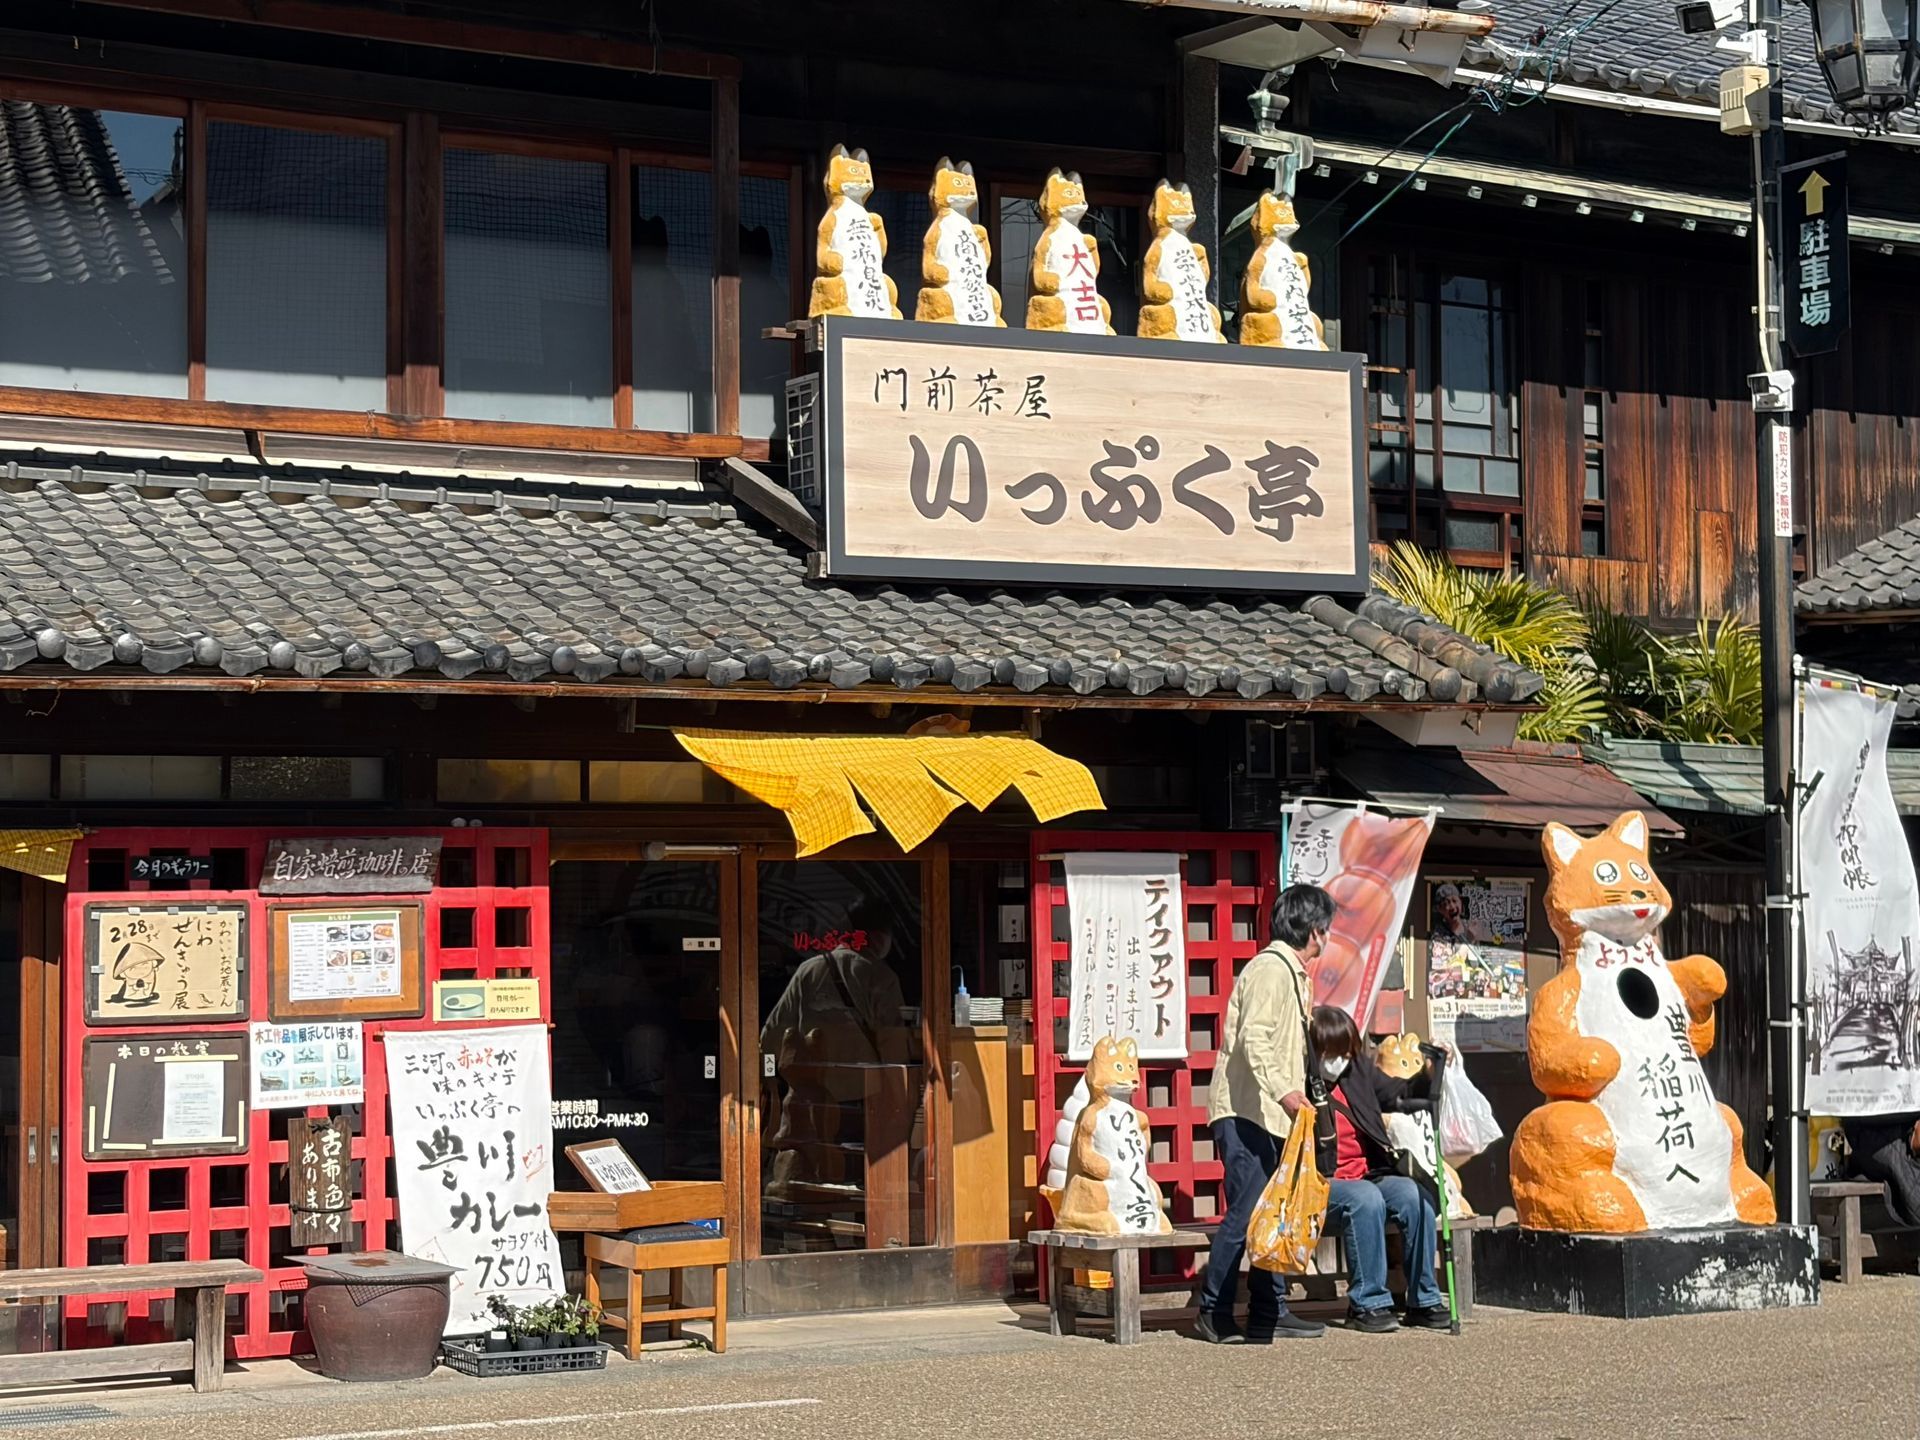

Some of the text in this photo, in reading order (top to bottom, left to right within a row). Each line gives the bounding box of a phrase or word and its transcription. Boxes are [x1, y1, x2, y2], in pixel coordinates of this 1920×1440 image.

[1062, 243, 1100, 322] 大吉
[1798, 218, 1831, 328] 駐車場
[873, 367, 1053, 419] 門前茶屋
[908, 434, 1326, 543] いっぷく亭
[1778, 431, 1790, 533] 防犯カメラ監視中
[134, 858, 209, 877] 今月のギャラリー
[273, 848, 433, 881] 自家焙煎珈琲の店
[1145, 879, 1175, 1039] テイクアウト
[1595, 940, 1661, 969] ようこそ
[1122, 936, 1142, 1034] 出来ます。
[117, 1040, 210, 1059] 本日の教室
[254, 1026, 359, 1044] 木工作品を展示しています。
[405, 1045, 517, 1075] 三河の赤みそが
[1669, 1005, 1712, 1107] 豊川
[303, 1089, 362, 1098] 中に入って見てね。
[416, 1092, 521, 1122] いっぷく亭の
[433, 1069, 517, 1095] 味のキメテ
[1637, 1055, 1701, 1184] 稲荷へ
[321, 1128, 345, 1234] 古布色々
[416, 1124, 516, 1191] 豊川
[1110, 1110, 1155, 1229] いっぷく亭
[302, 1142, 321, 1230] あります
[449, 1191, 542, 1234] カレー
[491, 1229, 549, 1252] サラダ付
[475, 1253, 553, 1290] 750円
